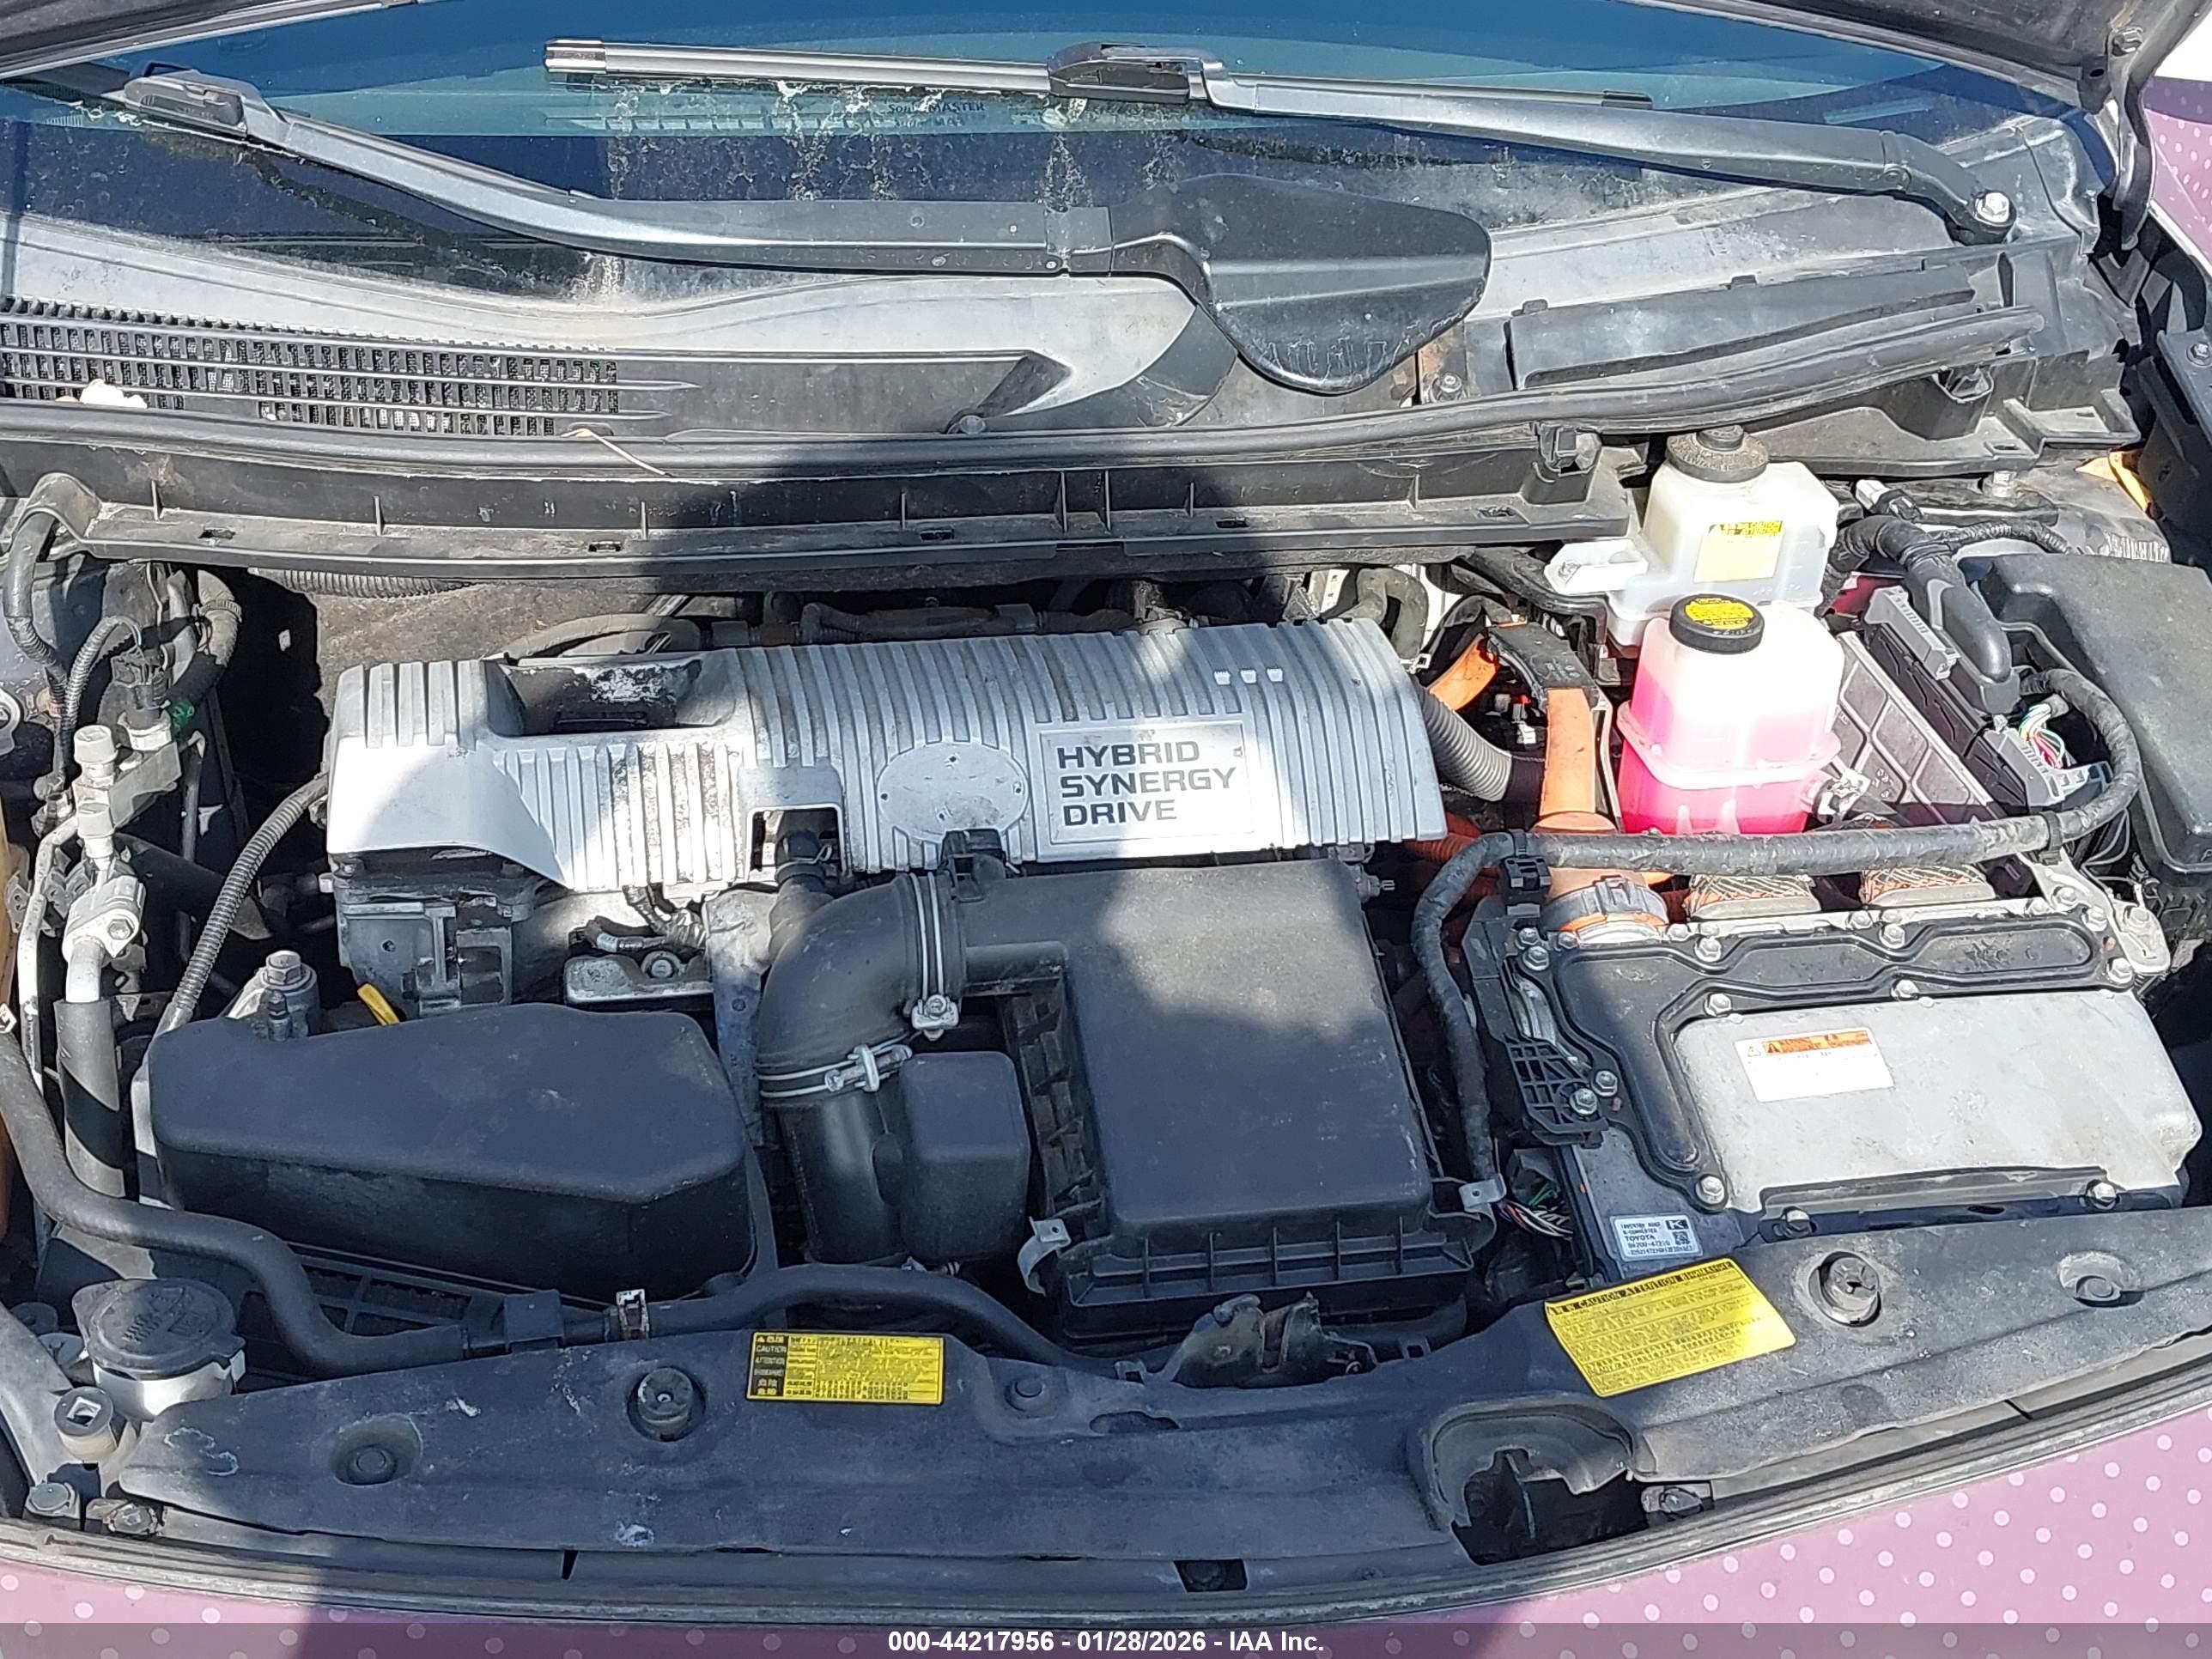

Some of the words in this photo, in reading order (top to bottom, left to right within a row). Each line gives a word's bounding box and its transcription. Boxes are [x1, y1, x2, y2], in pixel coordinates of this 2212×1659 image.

[1057, 740, 1200, 769] HYBRID
[1060, 767, 1237, 798] SYNERGY
[1063, 799, 1177, 826] DRIVE
[1580, 1291, 1620, 1307] CAUTION
[757, 1345, 787, 1353] CAUTION
